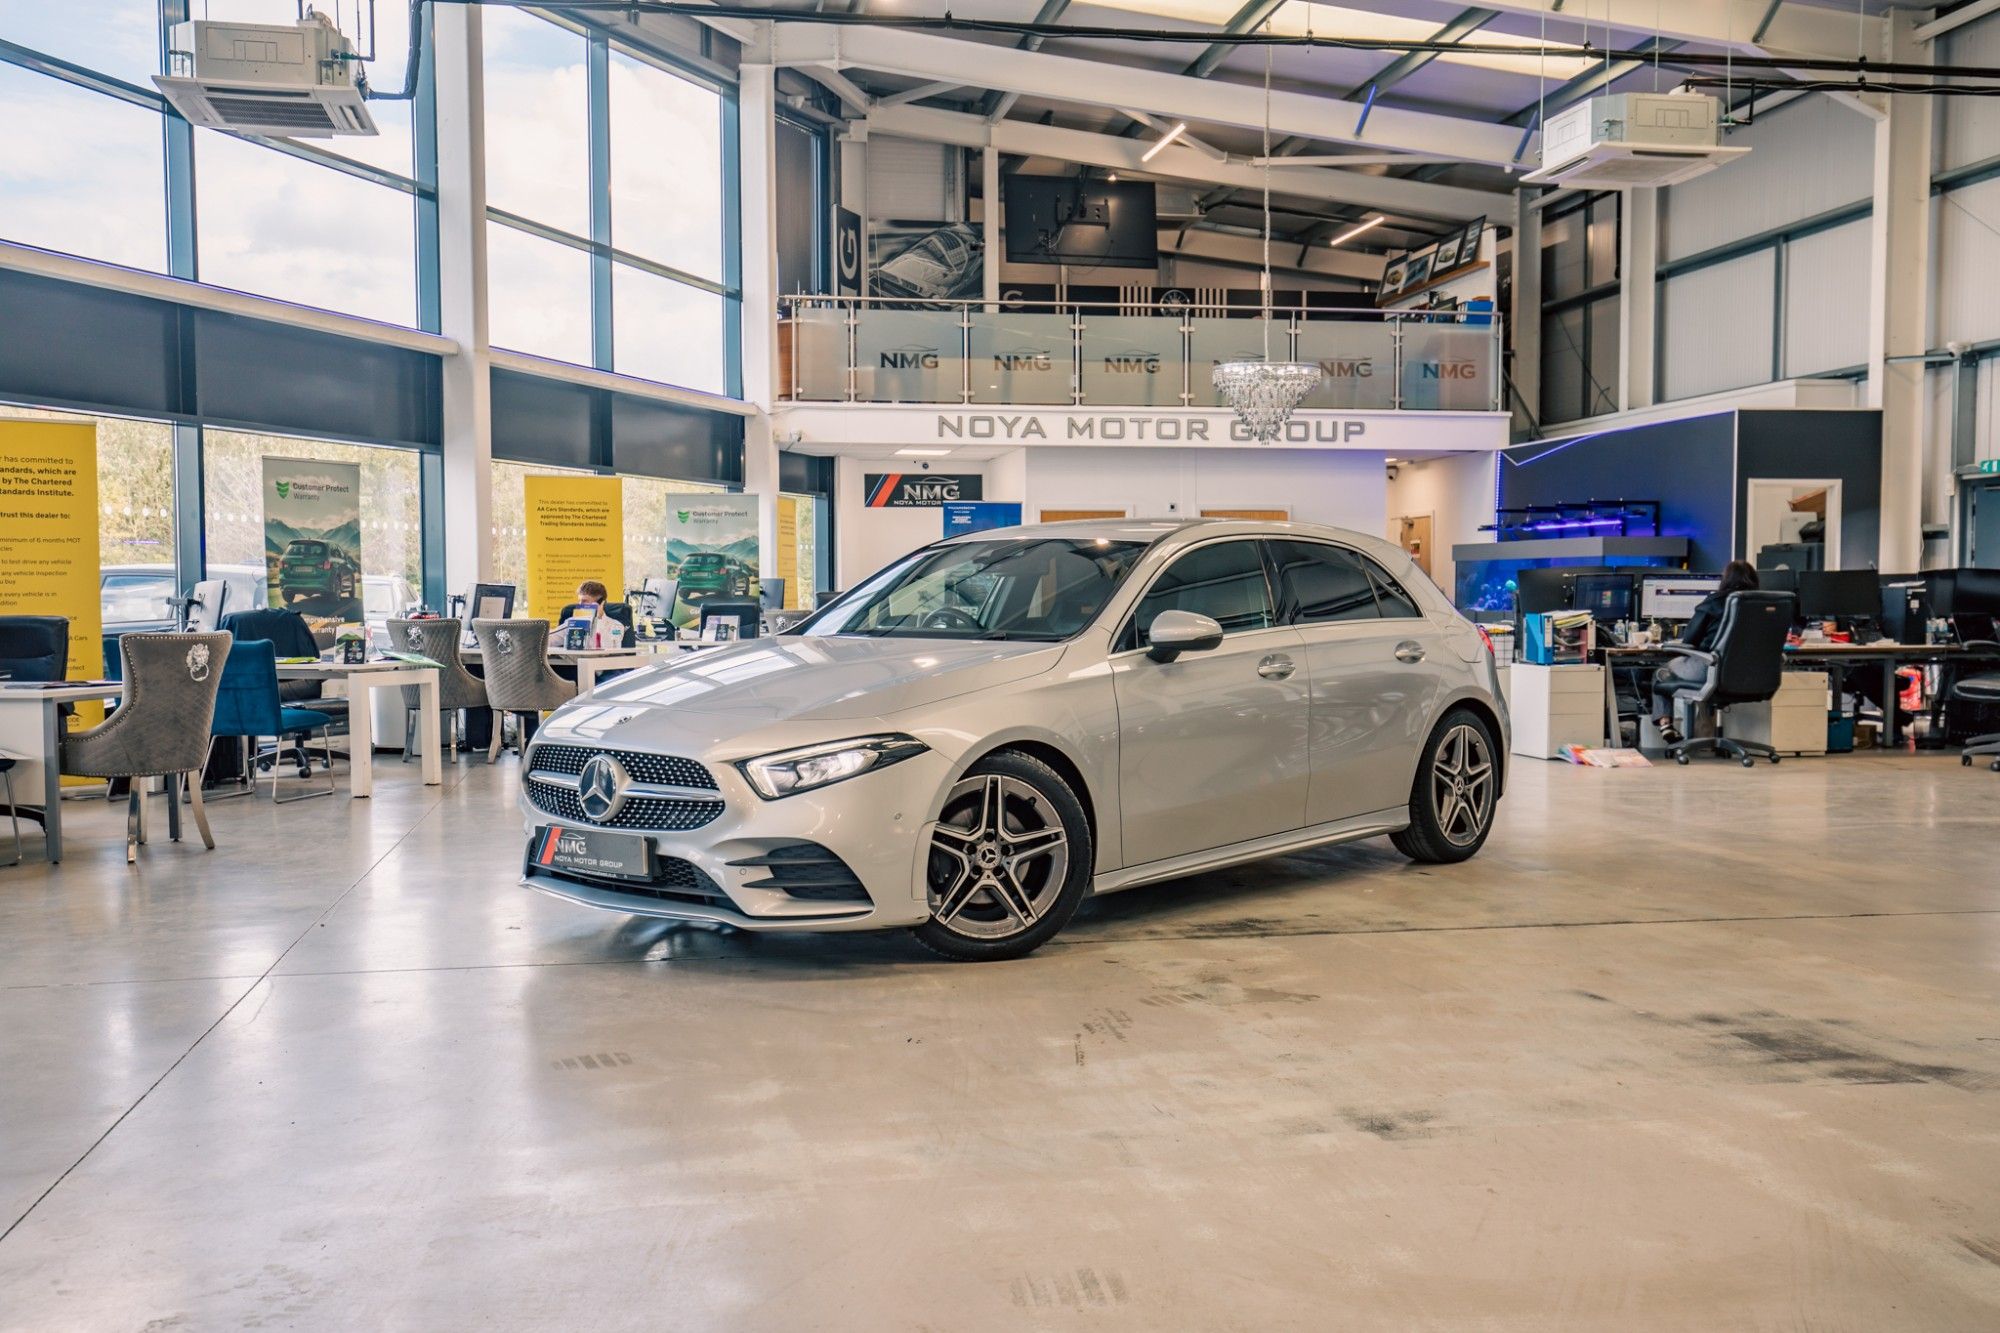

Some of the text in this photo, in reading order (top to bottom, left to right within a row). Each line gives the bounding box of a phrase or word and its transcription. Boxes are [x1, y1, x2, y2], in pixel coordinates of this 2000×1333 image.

[880, 352, 940, 369] NMG
[993, 354, 1052, 371] NMG
[1103, 357, 1161, 374] NMG
[1319, 361, 1373, 378] NMG
[1422, 363, 1476, 379] NMG
[937, 415, 1048, 439] NOYA
[1067, 416, 1210, 441] MOTOR
[4, 455, 18, 463] has
[20, 456, 64, 464] committed
[37, 467, 62, 475] which
[2, 477, 72, 486] by The Chartered
[292, 482, 349, 493] Customer Protect
[37, 488, 74, 497] Institute.
[293, 492, 320, 501] Warranty
[903, 484, 960, 500] NMG
[553, 838, 587, 855] NMG
[554, 855, 624, 868] NOYA MOTOR GROUP
